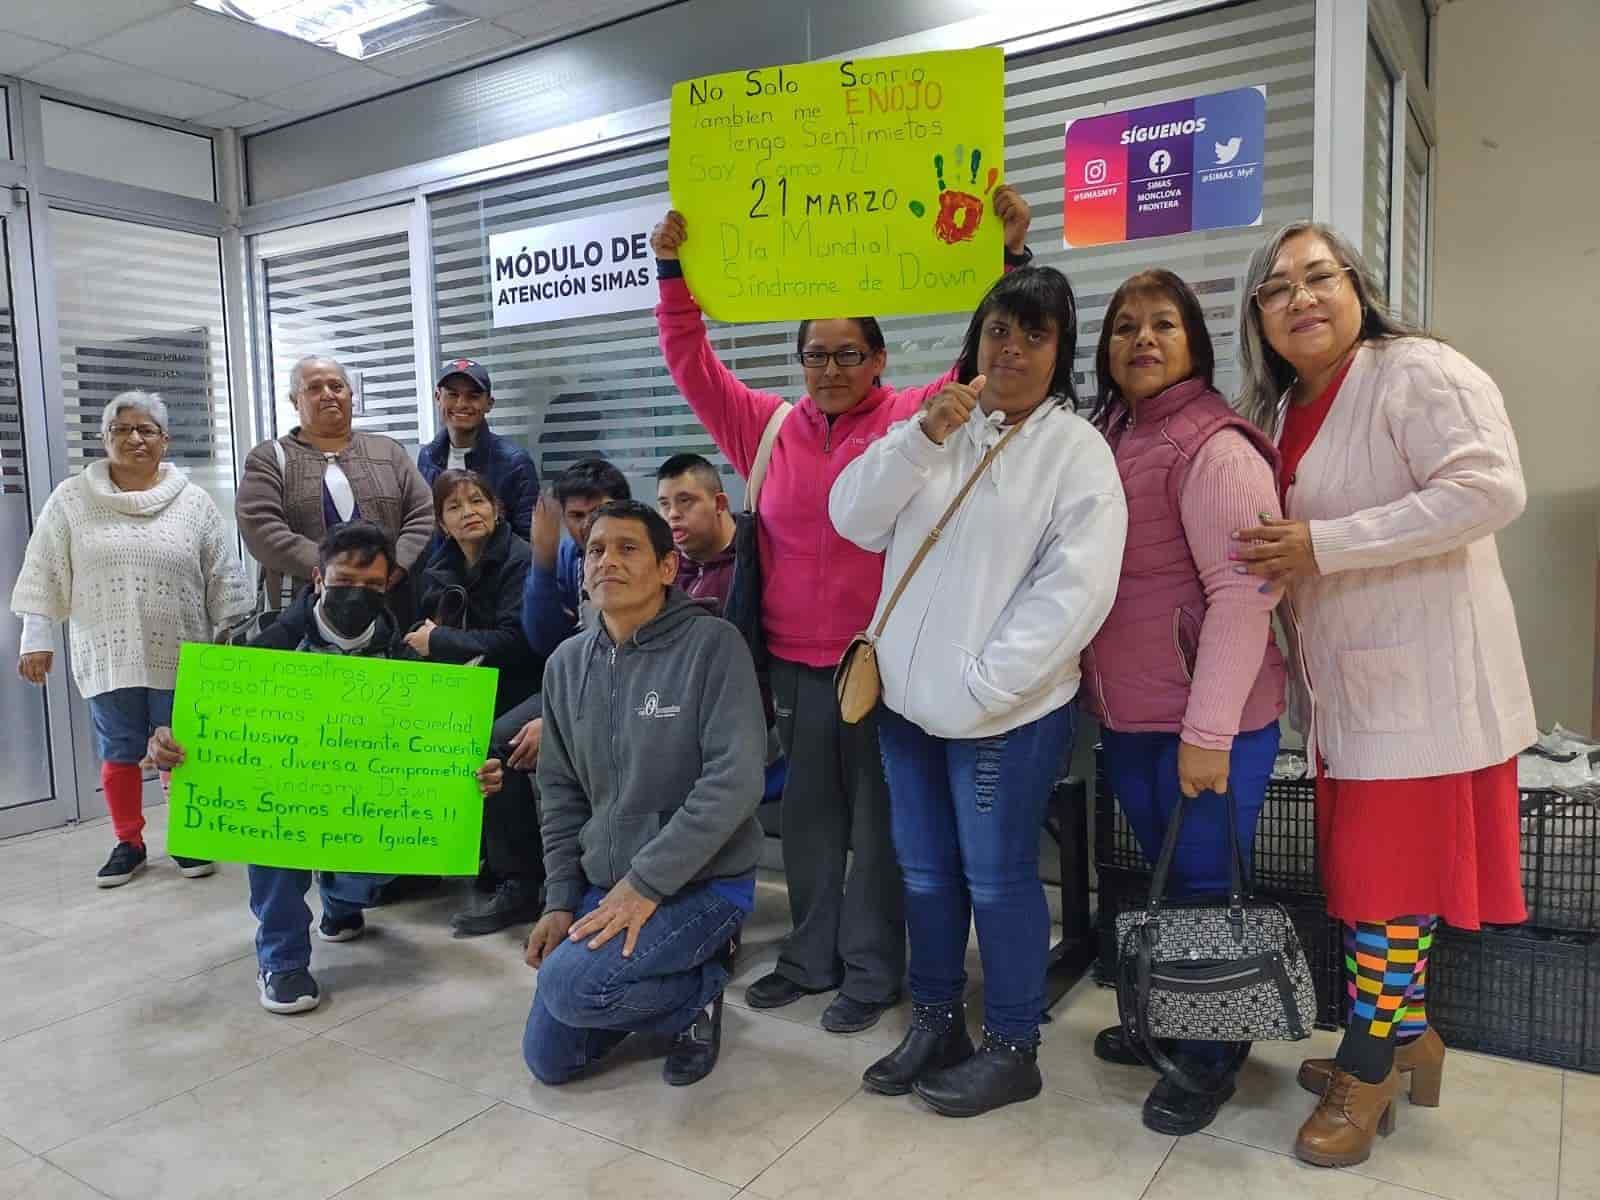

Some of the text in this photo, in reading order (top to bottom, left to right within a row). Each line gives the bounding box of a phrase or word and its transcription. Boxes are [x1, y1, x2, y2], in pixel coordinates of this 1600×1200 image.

[689, 79, 723, 106] No
[745, 68, 799, 97] Solo
[794, 106, 823, 121] me
[845, 80, 944, 116] ENOJO
[1120, 117, 1207, 144] SÍGUENOS
[688, 153, 736, 183] Soy
[756, 158, 823, 177] Como
[1146, 179, 1172, 190] SIMAS
[750, 176, 898, 219] 21 MARZO
[1136, 189, 1182, 202] MONCLOVA
[1138, 200, 1179, 213] FRONTERA
[496, 232, 648, 281] MÓDULO DE
[782, 220, 891, 262] Mundial
[498, 267, 650, 306] ATENCIÓN SIMAS
[859, 264, 882, 292] de
[898, 252, 976, 290] Down
[200, 672, 411, 706] nosotros 2023
[282, 747, 358, 773] diversa
[184, 782, 248, 811] Todos
[256, 792, 329, 816] Somos
[342, 793, 433, 822] diferentes
[184, 804, 439, 851] Diferentes pero Iguales
